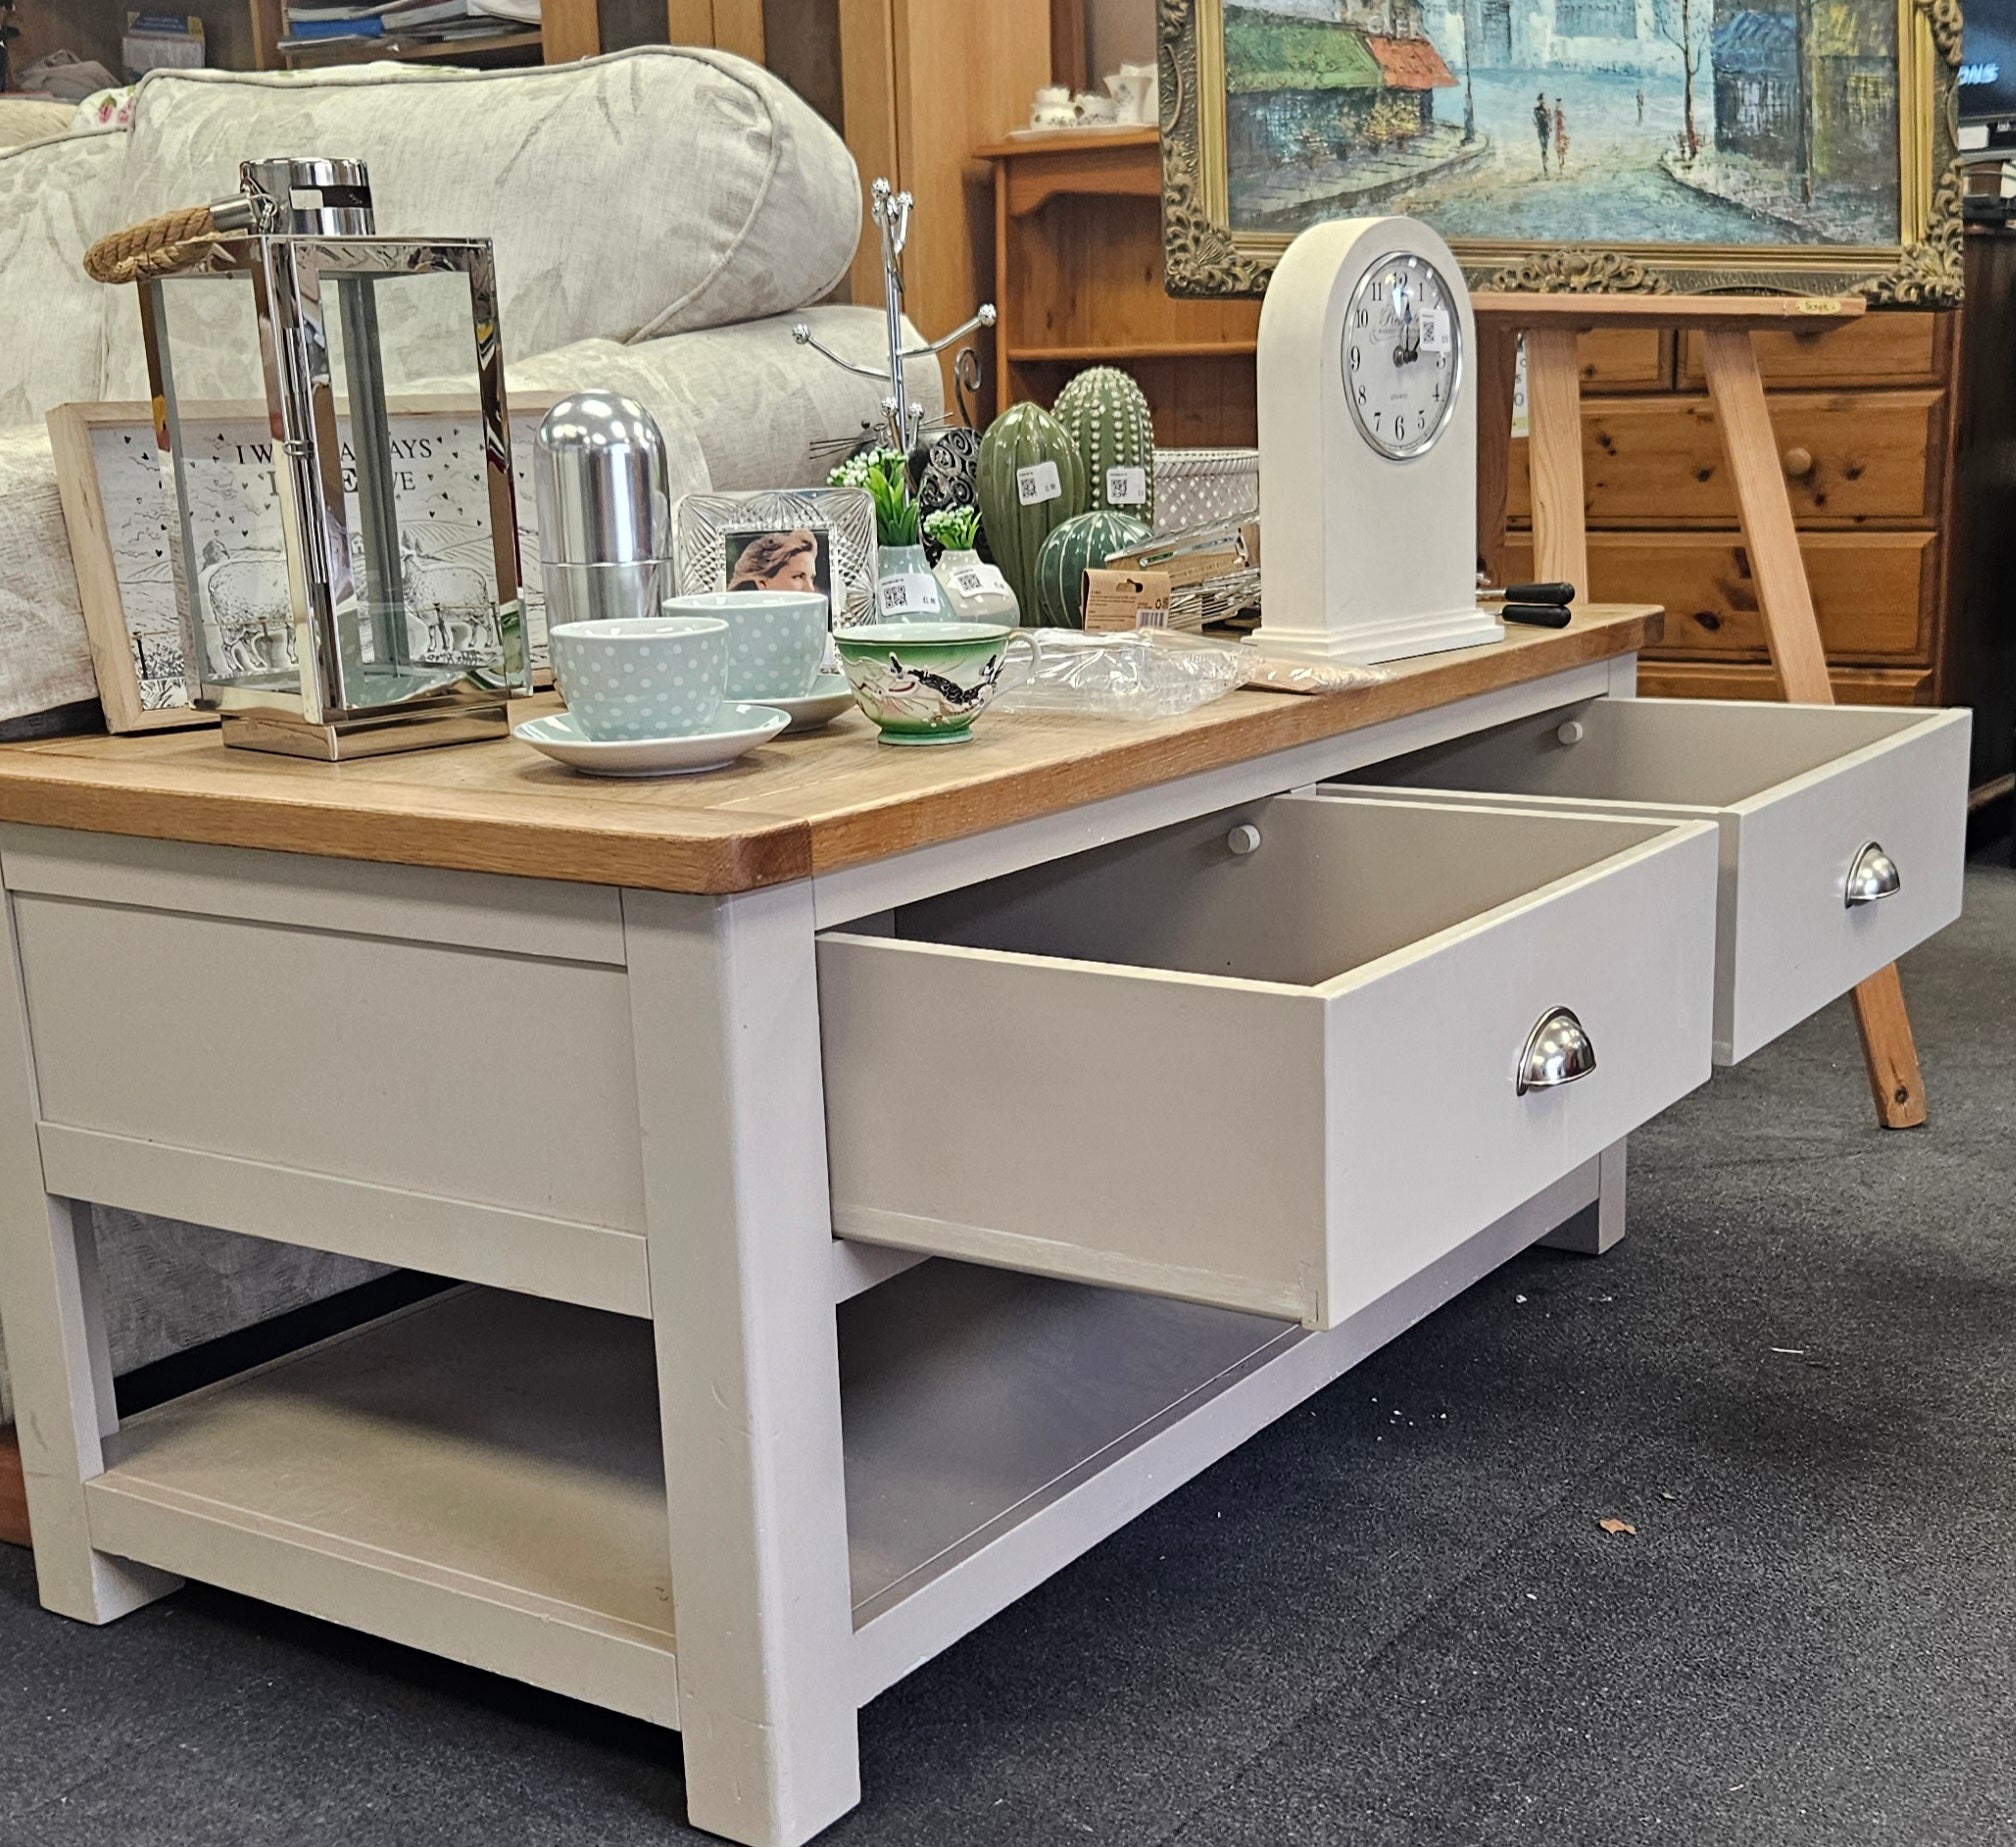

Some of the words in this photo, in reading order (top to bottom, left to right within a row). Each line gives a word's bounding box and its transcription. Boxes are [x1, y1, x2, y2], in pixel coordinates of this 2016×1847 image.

[1372, 282, 1382, 301] 11
[1357, 308, 1369, 328] 10
[1350, 345, 1361, 372] 9
[1358, 385, 1367, 405] 8
[1432, 382, 1440, 402] 4
[1373, 411, 1382, 432] 7
[1394, 415, 1405, 441] 6
[1417, 409, 1425, 429] 5
[340, 438, 433, 462] AAYS
